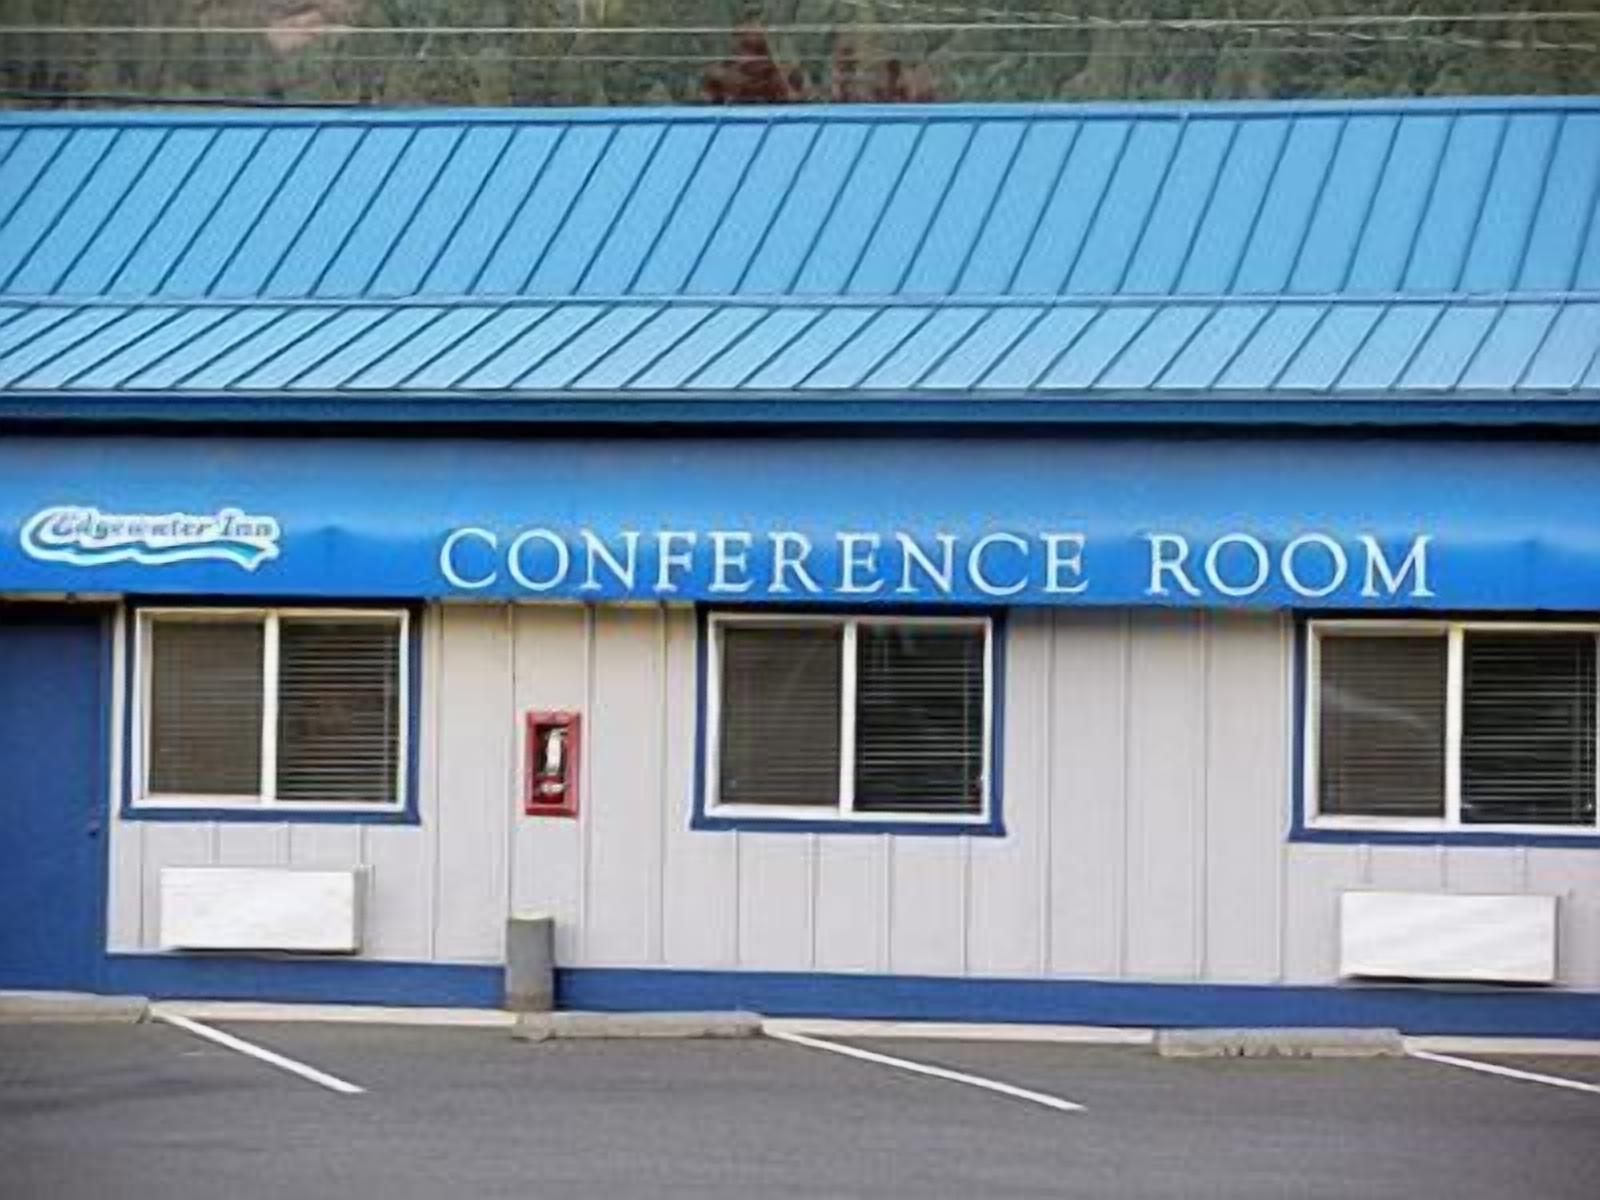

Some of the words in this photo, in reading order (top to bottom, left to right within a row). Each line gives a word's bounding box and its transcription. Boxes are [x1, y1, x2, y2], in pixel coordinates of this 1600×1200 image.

[217, 510, 273, 538] Inn
[439, 527, 1089, 597] CONFERENCE
[1145, 532, 1436, 598] ROOM
